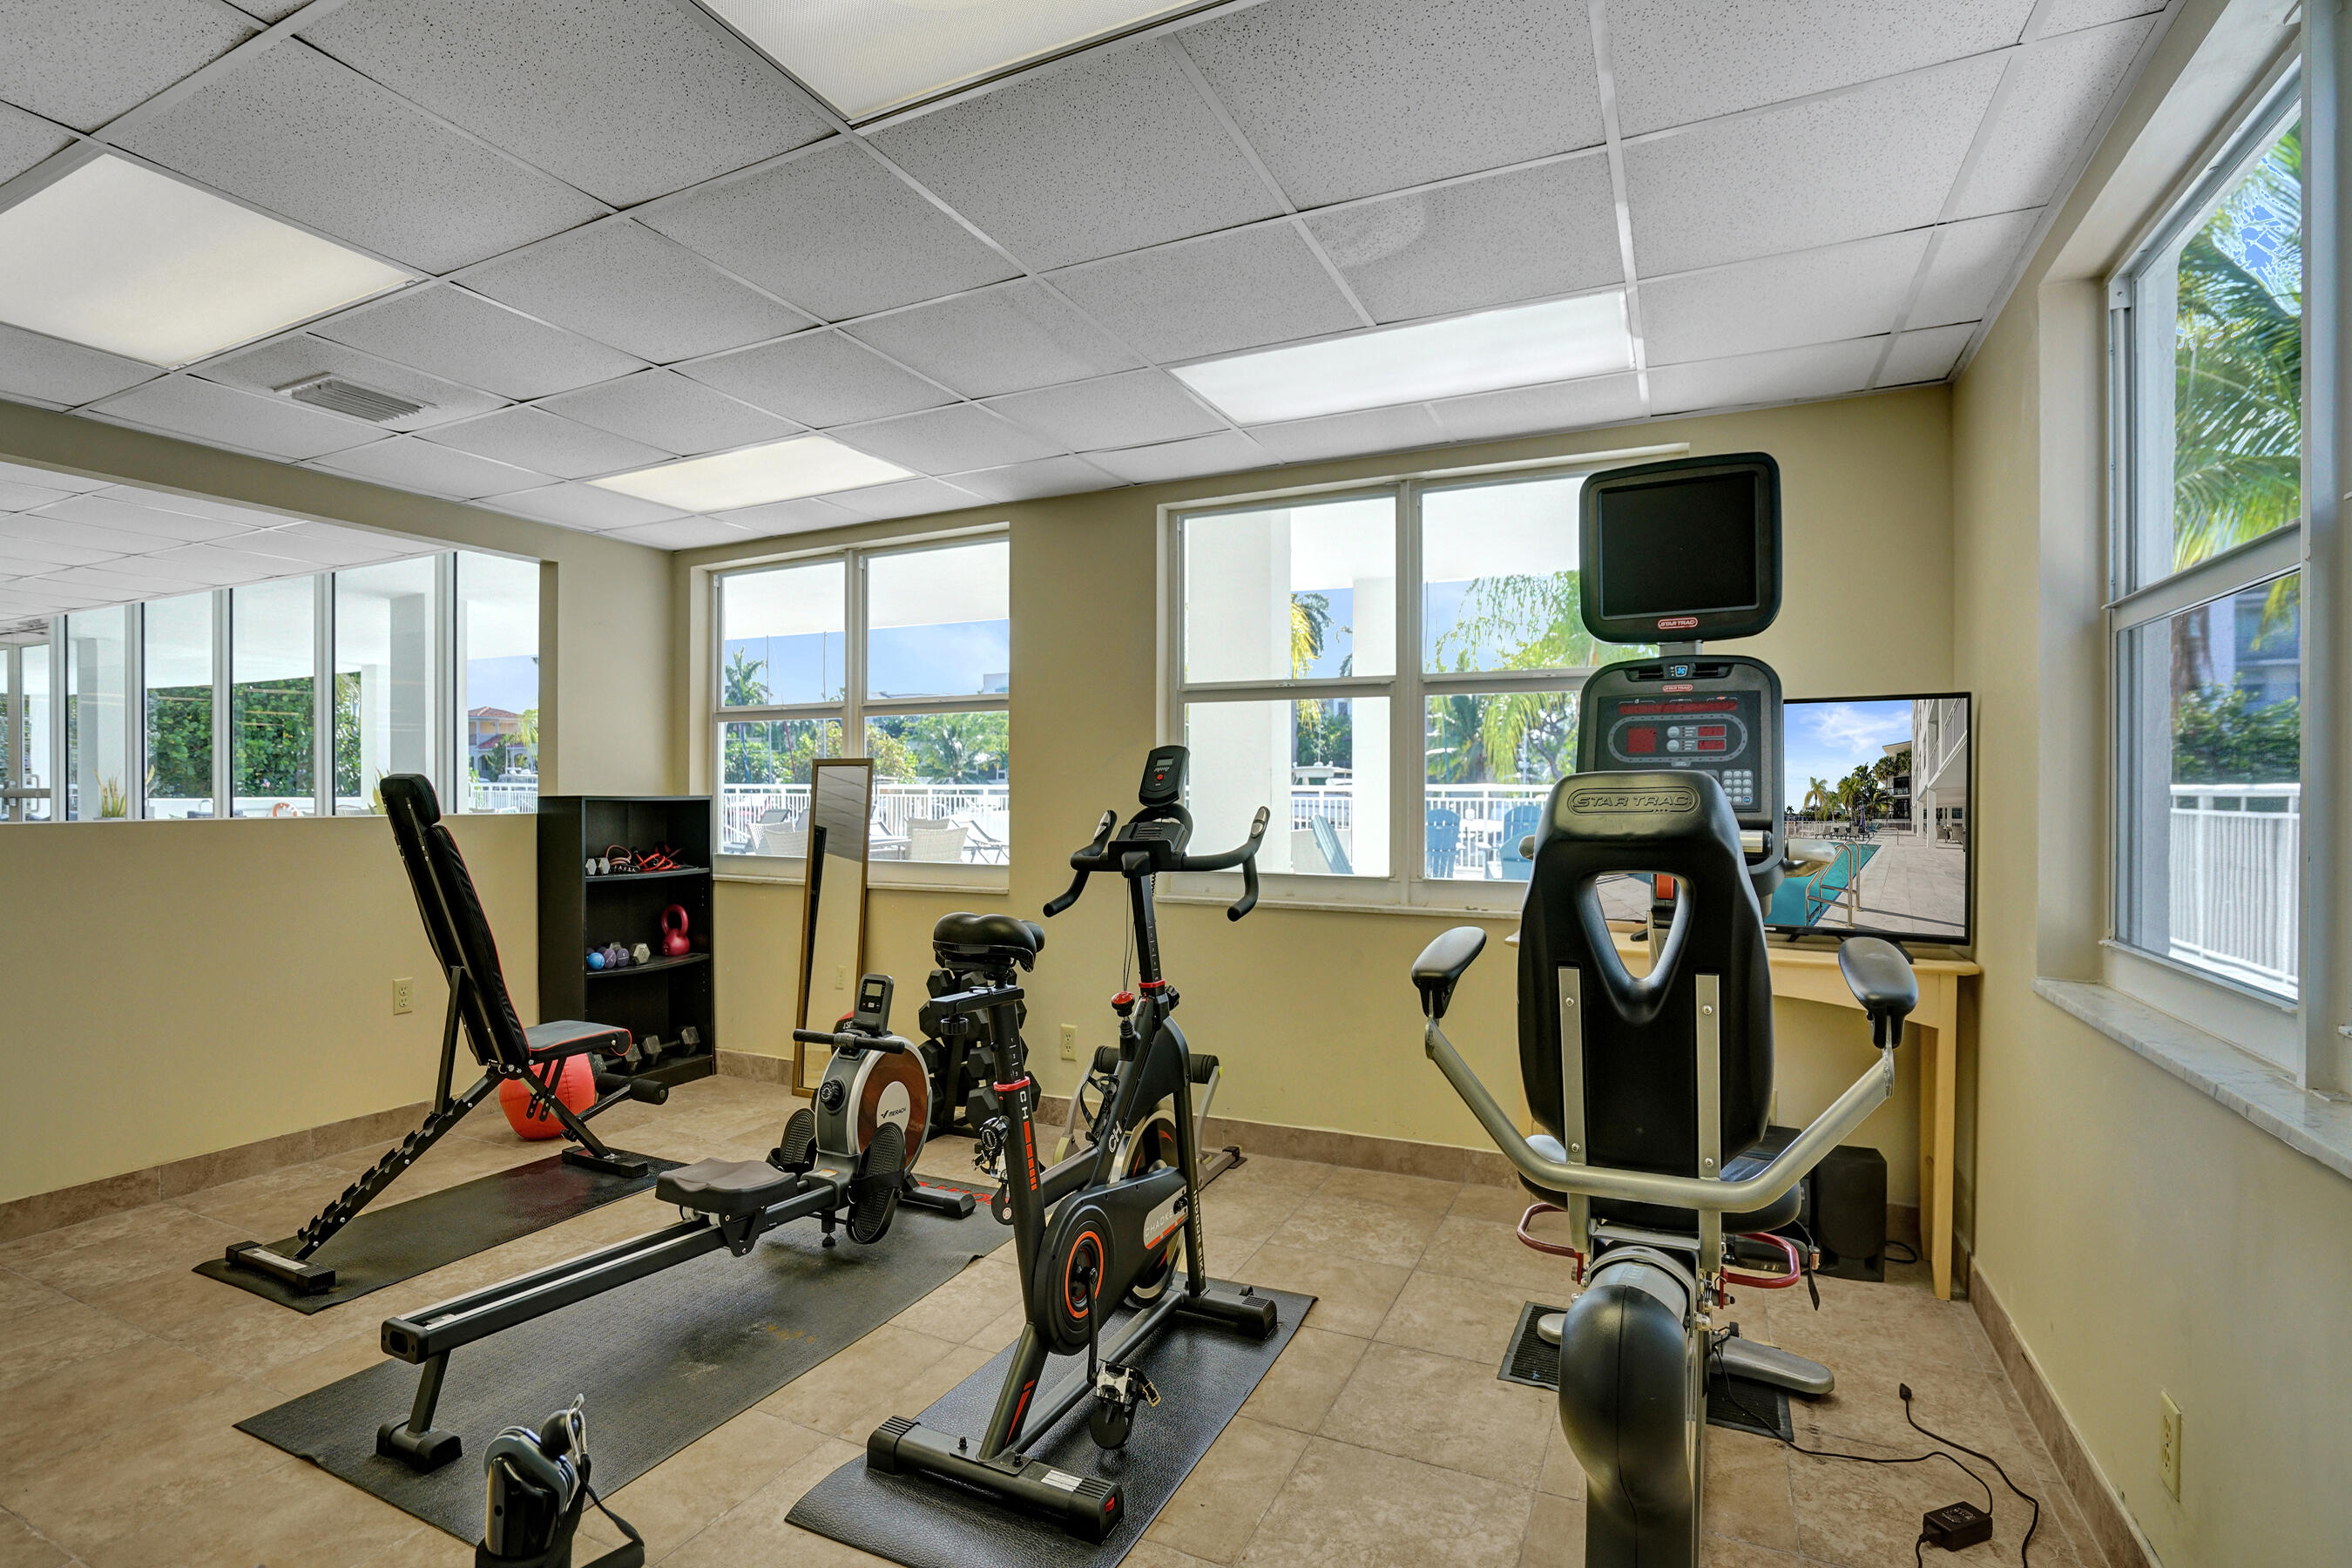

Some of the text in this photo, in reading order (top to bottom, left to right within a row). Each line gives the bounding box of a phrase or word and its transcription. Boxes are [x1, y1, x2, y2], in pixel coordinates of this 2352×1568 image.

[1573, 795, 1689, 808] STAR TRAC
[1108, 1120, 1123, 1153] CH
[1193, 1189, 1202, 1244] INDOOR
